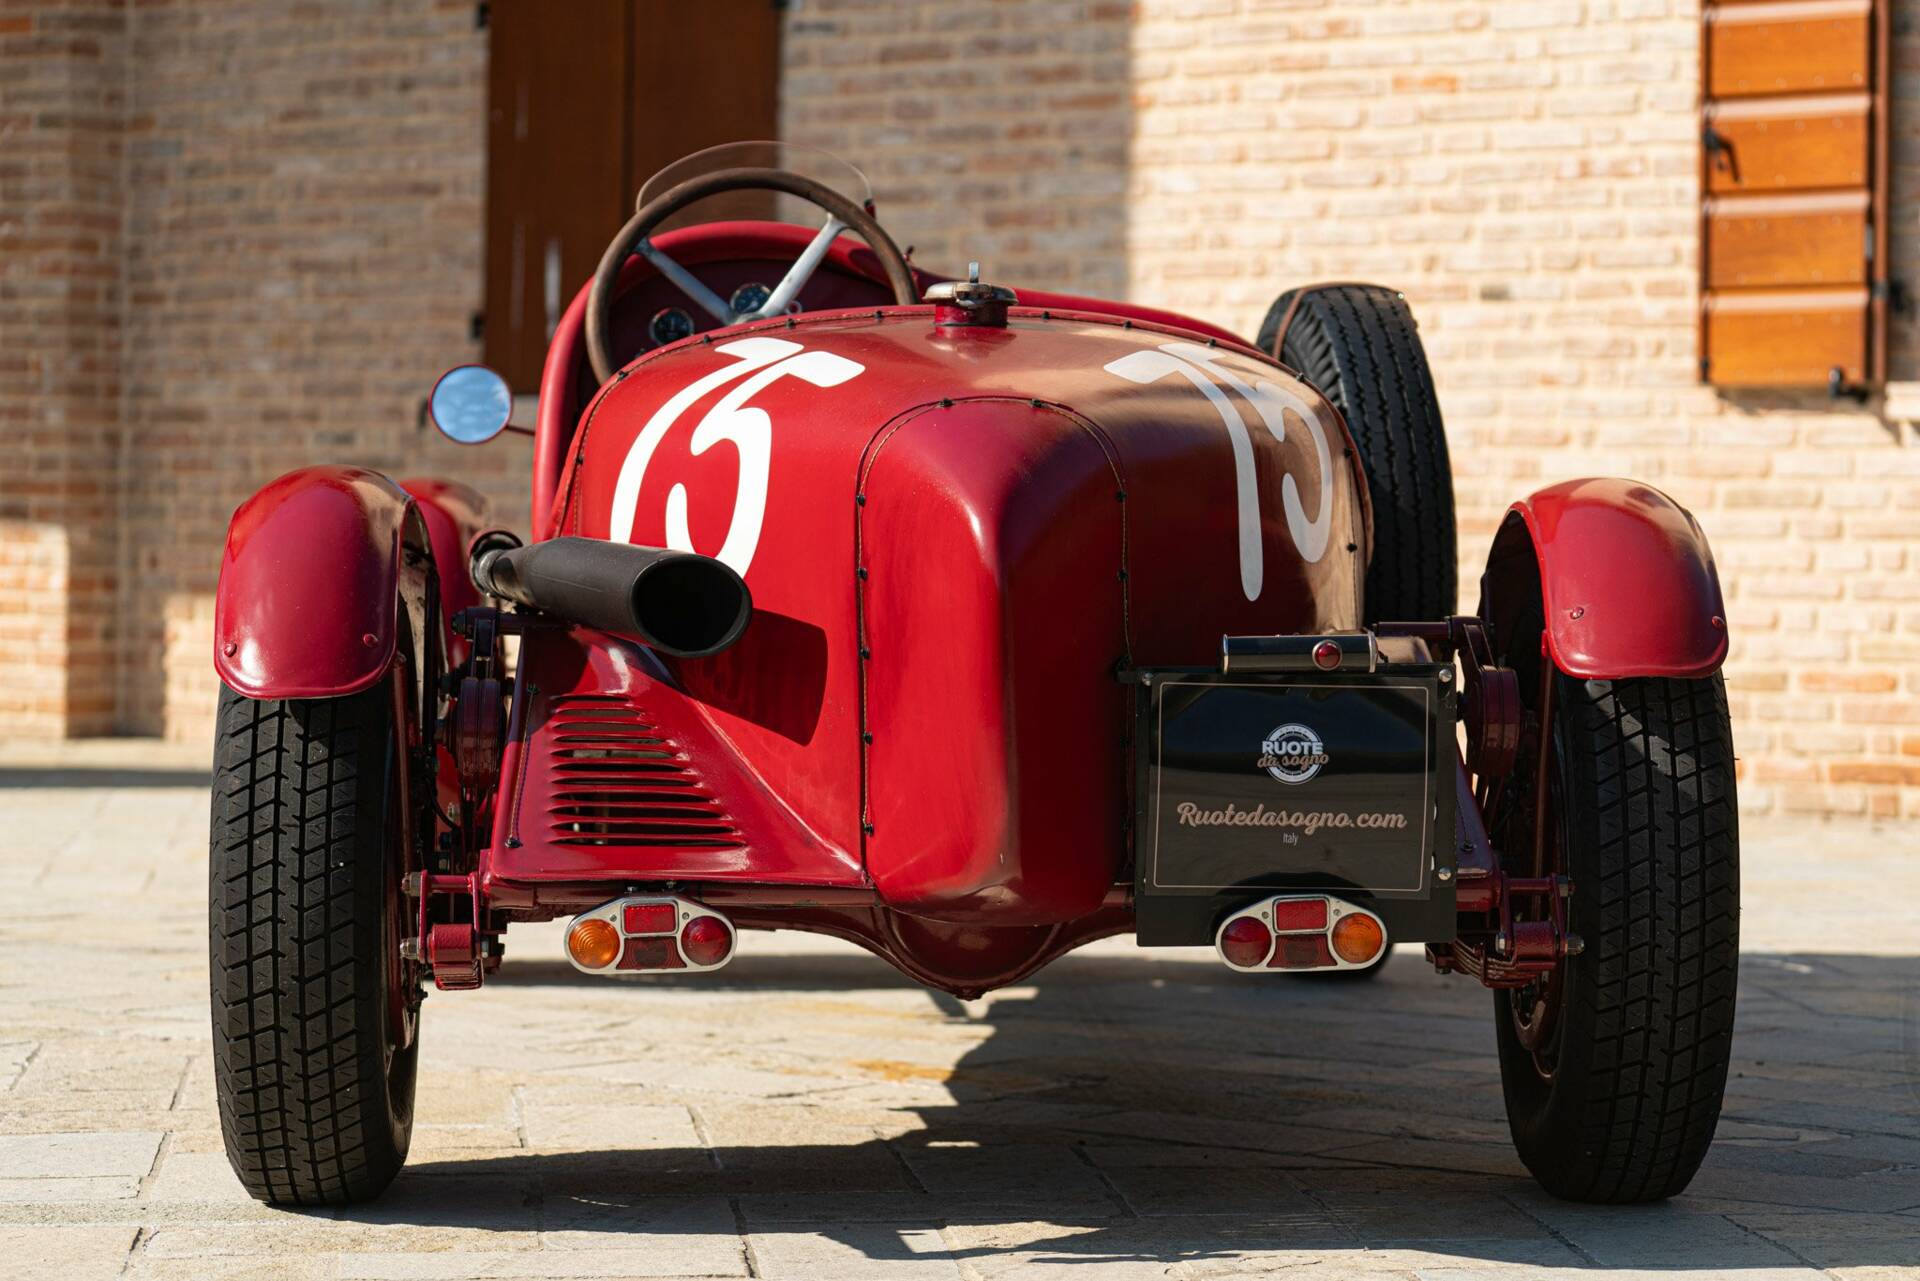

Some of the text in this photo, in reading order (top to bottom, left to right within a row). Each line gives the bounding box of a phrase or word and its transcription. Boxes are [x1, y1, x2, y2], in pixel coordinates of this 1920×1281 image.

[1262, 740, 1323, 756] RUOTE
[1257, 753, 1330, 772] da sogno
[1176, 801, 1408, 836] Ruotedasogno.com
[1282, 832, 1299, 846] Italy
